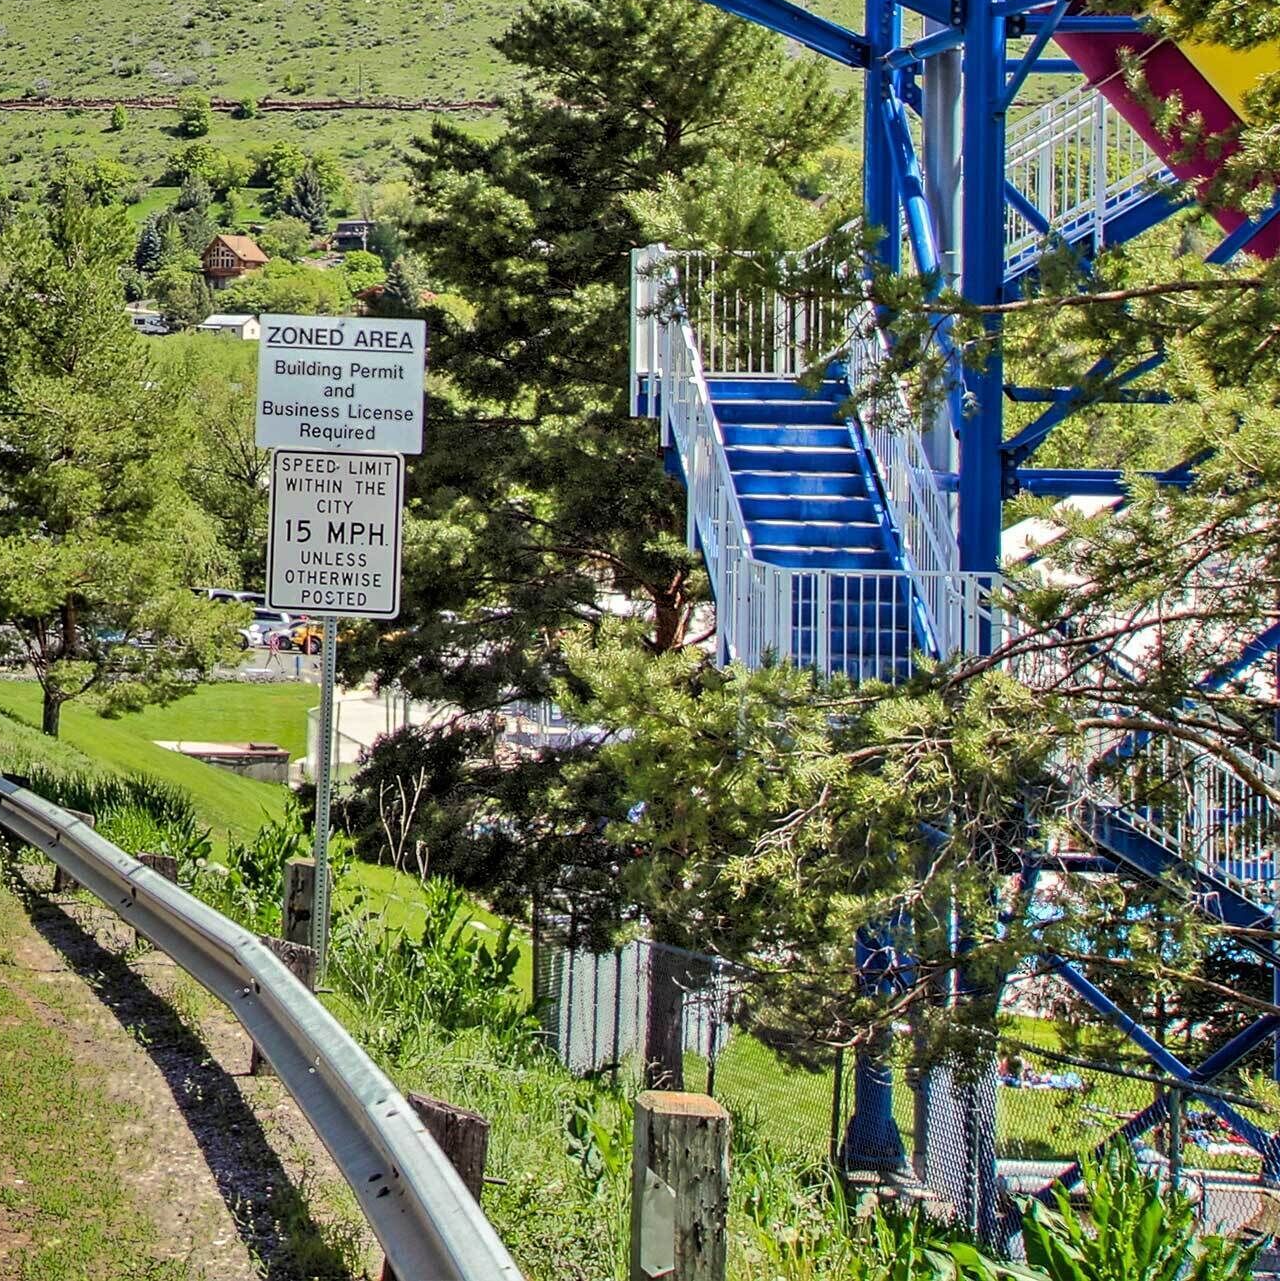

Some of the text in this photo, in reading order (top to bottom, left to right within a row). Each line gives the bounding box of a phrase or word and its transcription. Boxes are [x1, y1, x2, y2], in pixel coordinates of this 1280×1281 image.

[267, 326, 414, 349] ZONED AREA
[275, 360, 404, 380] Building Permit
[324, 383, 355, 399] and
[263, 401, 414, 421] Business License
[300, 423, 376, 442] Required
[282, 457, 393, 477] SPEED LIMIT
[286, 478, 387, 496] WITHIN THE
[317, 499, 354, 515] CITY
[285, 519, 389, 547] 15 M.P.H.
[301, 551, 368, 567] UNLESS
[285, 569, 382, 588] OTHERWISE
[301, 590, 368, 607] POSTED
